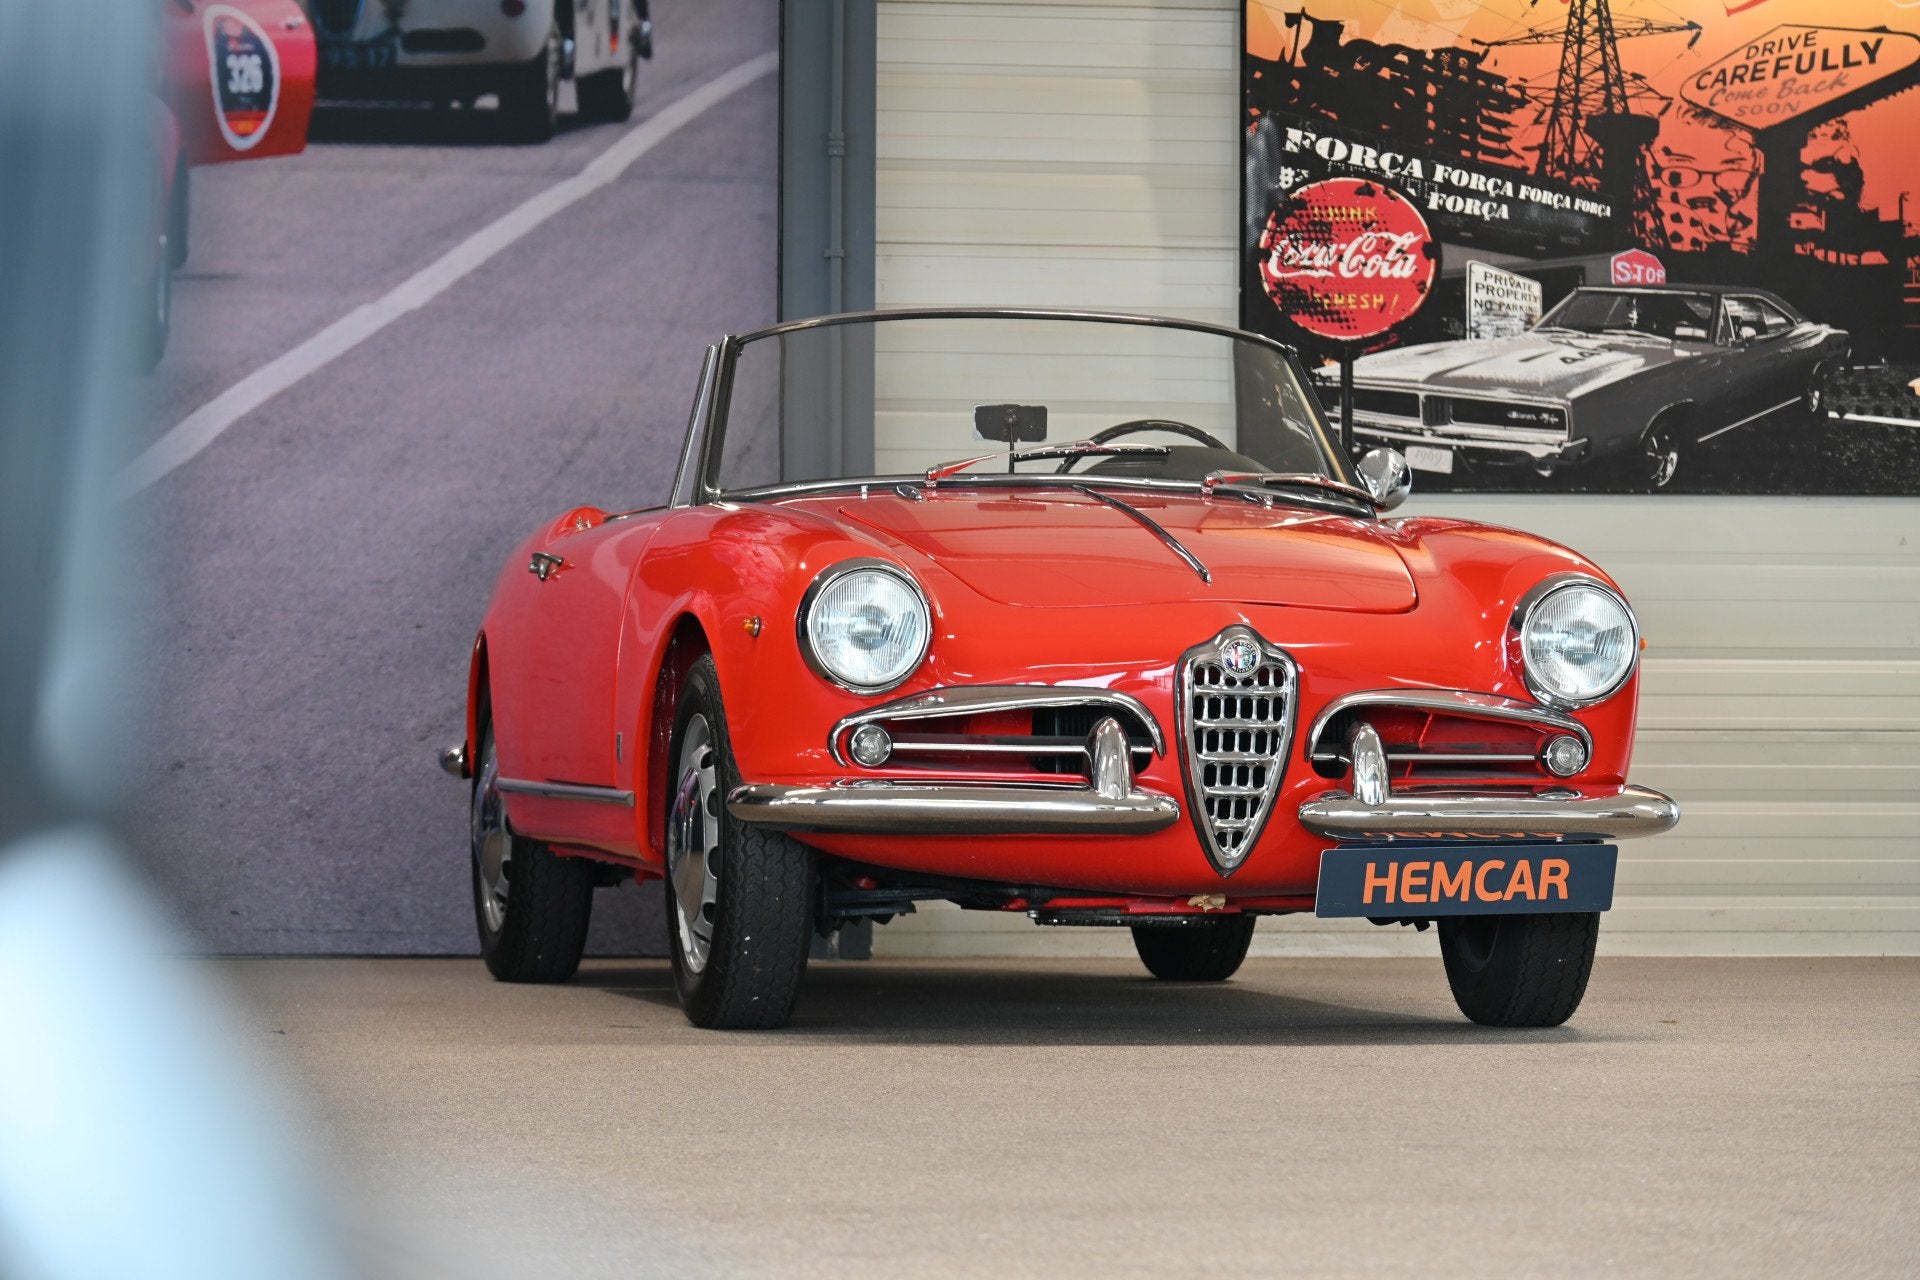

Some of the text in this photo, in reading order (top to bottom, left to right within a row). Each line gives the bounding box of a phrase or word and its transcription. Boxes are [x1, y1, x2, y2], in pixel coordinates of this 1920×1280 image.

[1745, 30, 1818, 60] DRIVE
[1695, 38, 1883, 91] CAREFULLY
[1708, 71, 1849, 107] Come Back
[1734, 100, 1801, 117] SOON
[1282, 127, 1424, 179] FORÇA
[1432, 163, 1514, 198] FORÇA
[1518, 184, 1571, 210] FORÇA
[1573, 197, 1612, 218] FORÇA
[1427, 191, 1510, 221] FORÇA
[1484, 271, 1533, 292] PRIVATE
[1615, 260, 1665, 284] STOP
[1474, 298, 1494, 312] NO
[1475, 282, 1539, 303] PROPERTY
[1362, 858, 1571, 904] HEMCAR
